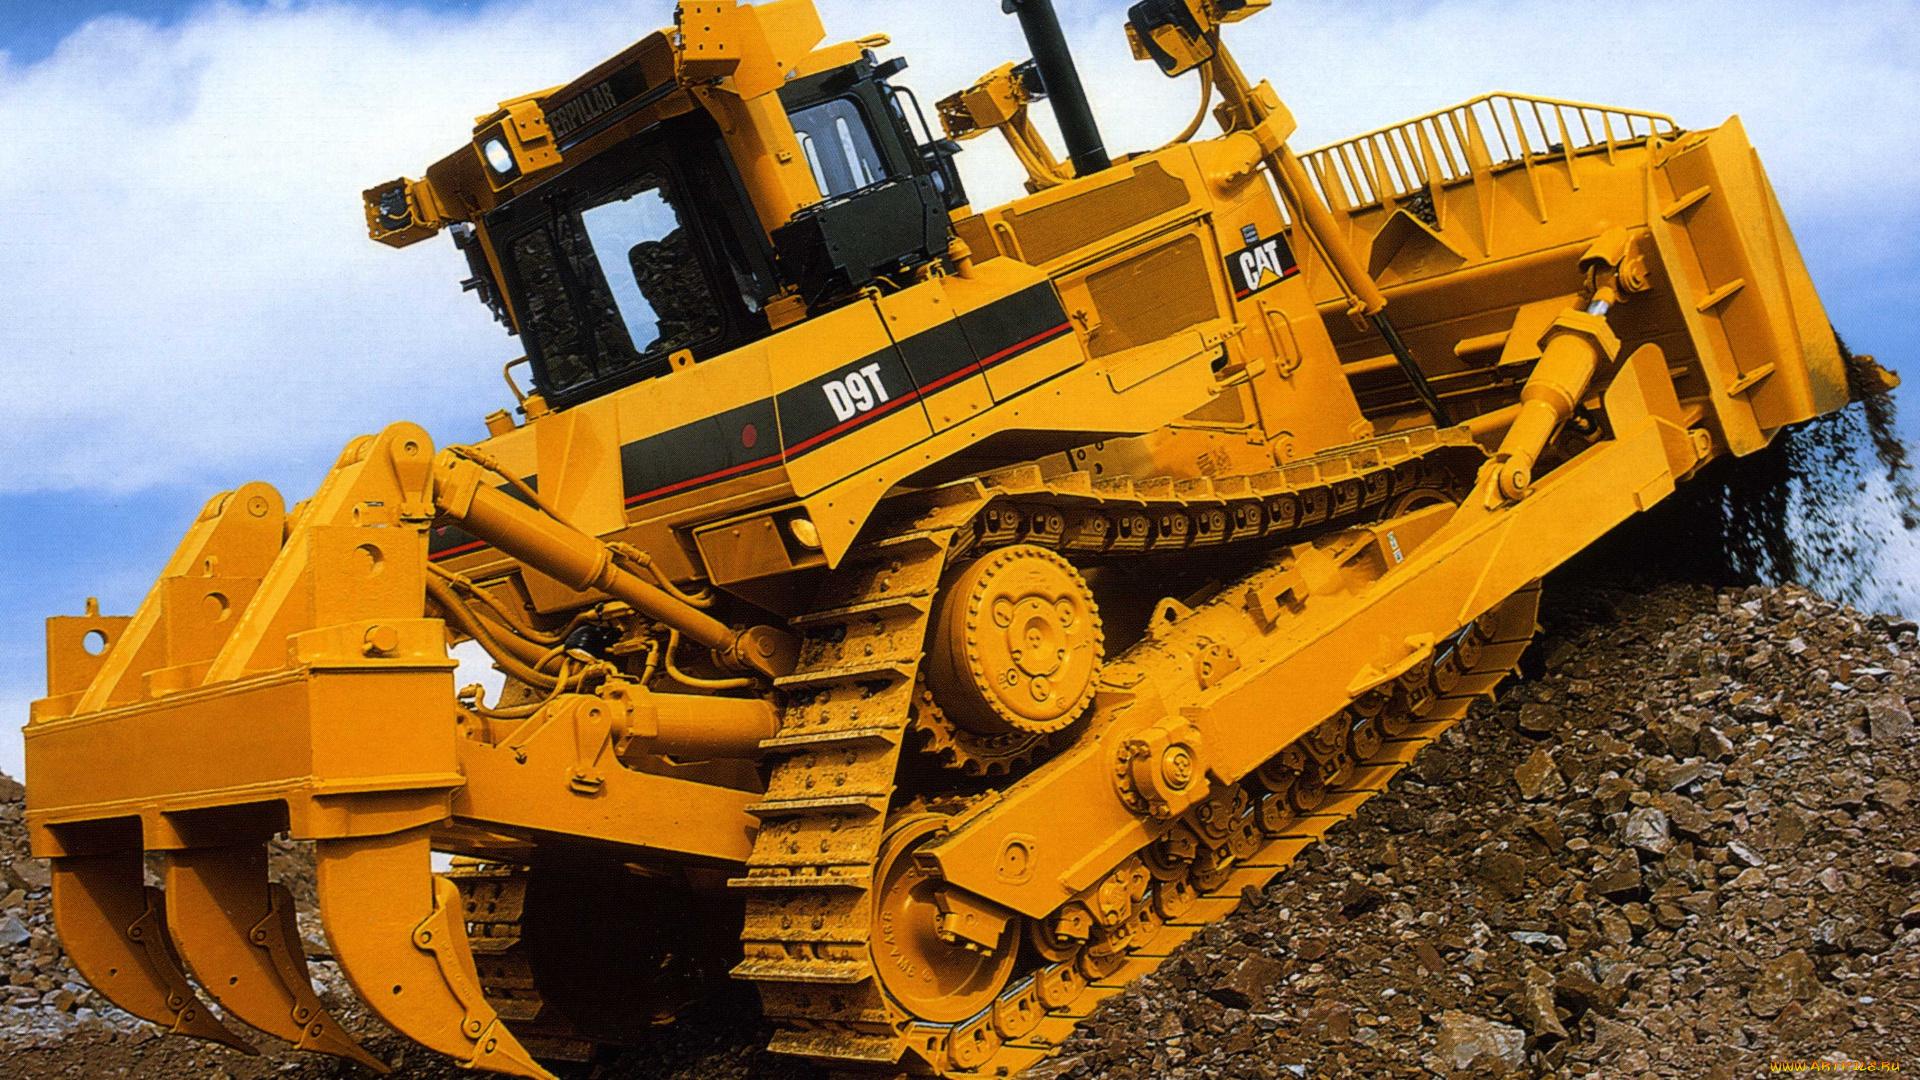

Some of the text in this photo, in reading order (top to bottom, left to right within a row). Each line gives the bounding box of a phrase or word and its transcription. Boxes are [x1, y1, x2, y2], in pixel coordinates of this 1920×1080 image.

[546, 82, 618, 138] ERPILLAR
[1239, 240, 1284, 290] CAT
[822, 363, 889, 422] D9T
